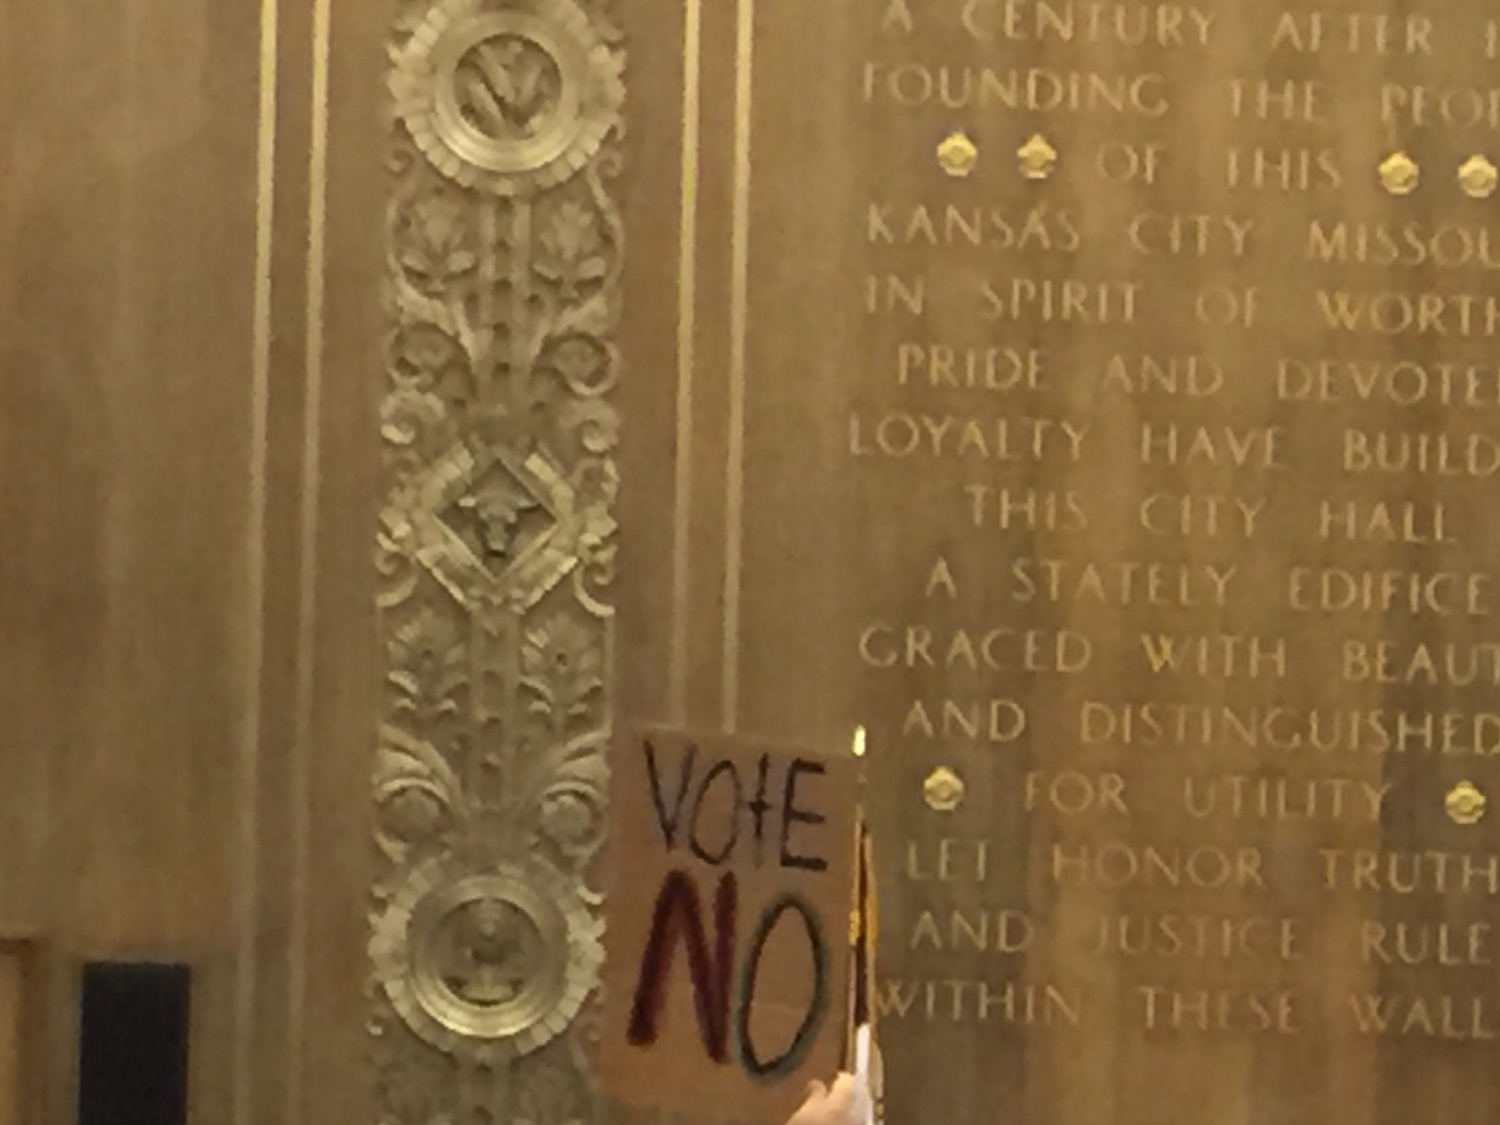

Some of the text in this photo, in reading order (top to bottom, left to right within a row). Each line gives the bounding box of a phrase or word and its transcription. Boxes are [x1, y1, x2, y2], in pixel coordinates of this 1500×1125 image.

[883, 0, 913, 32] A
[961, 0, 1213, 46] CENTURY
[1271, 11, 1433, 54] AFTER
[863, 62, 1169, 118] FOUNDING
[1230, 78, 1325, 122] THE
[1103, 146, 1341, 189] OF THIS
[867, 204, 1080, 252] KANSAS
[1130, 213, 1254, 257] CITY
[865, 274, 924, 315] IN
[981, 279, 1145, 323] SPIRIT
[1197, 288, 1260, 329] OF
[898, 344, 1047, 391] PRIDE
[1104, 353, 1224, 397] AND
[849, 415, 1090, 461] LOYALTY
[1140, 423, 1288, 468] HAVE
[964, 485, 1457, 543] THIS CITY HALL
[925, 556, 1493, 616] A STATELY EDIFICE
[858, 625, 1093, 673] GRACED
[1140, 633, 1287, 679] WITH
[903, 700, 1026, 743] AND
[1025, 771, 1393, 823] FOR UTILITY
[906, 838, 1499, 896] LET HONOR TRUTH
[911, 909, 1493, 966] AND JUSTICE RULE
[626, 868, 832, 1083] NO
[877, 979, 1082, 1023] WITHIN
[1138, 985, 1296, 1034] THESE
